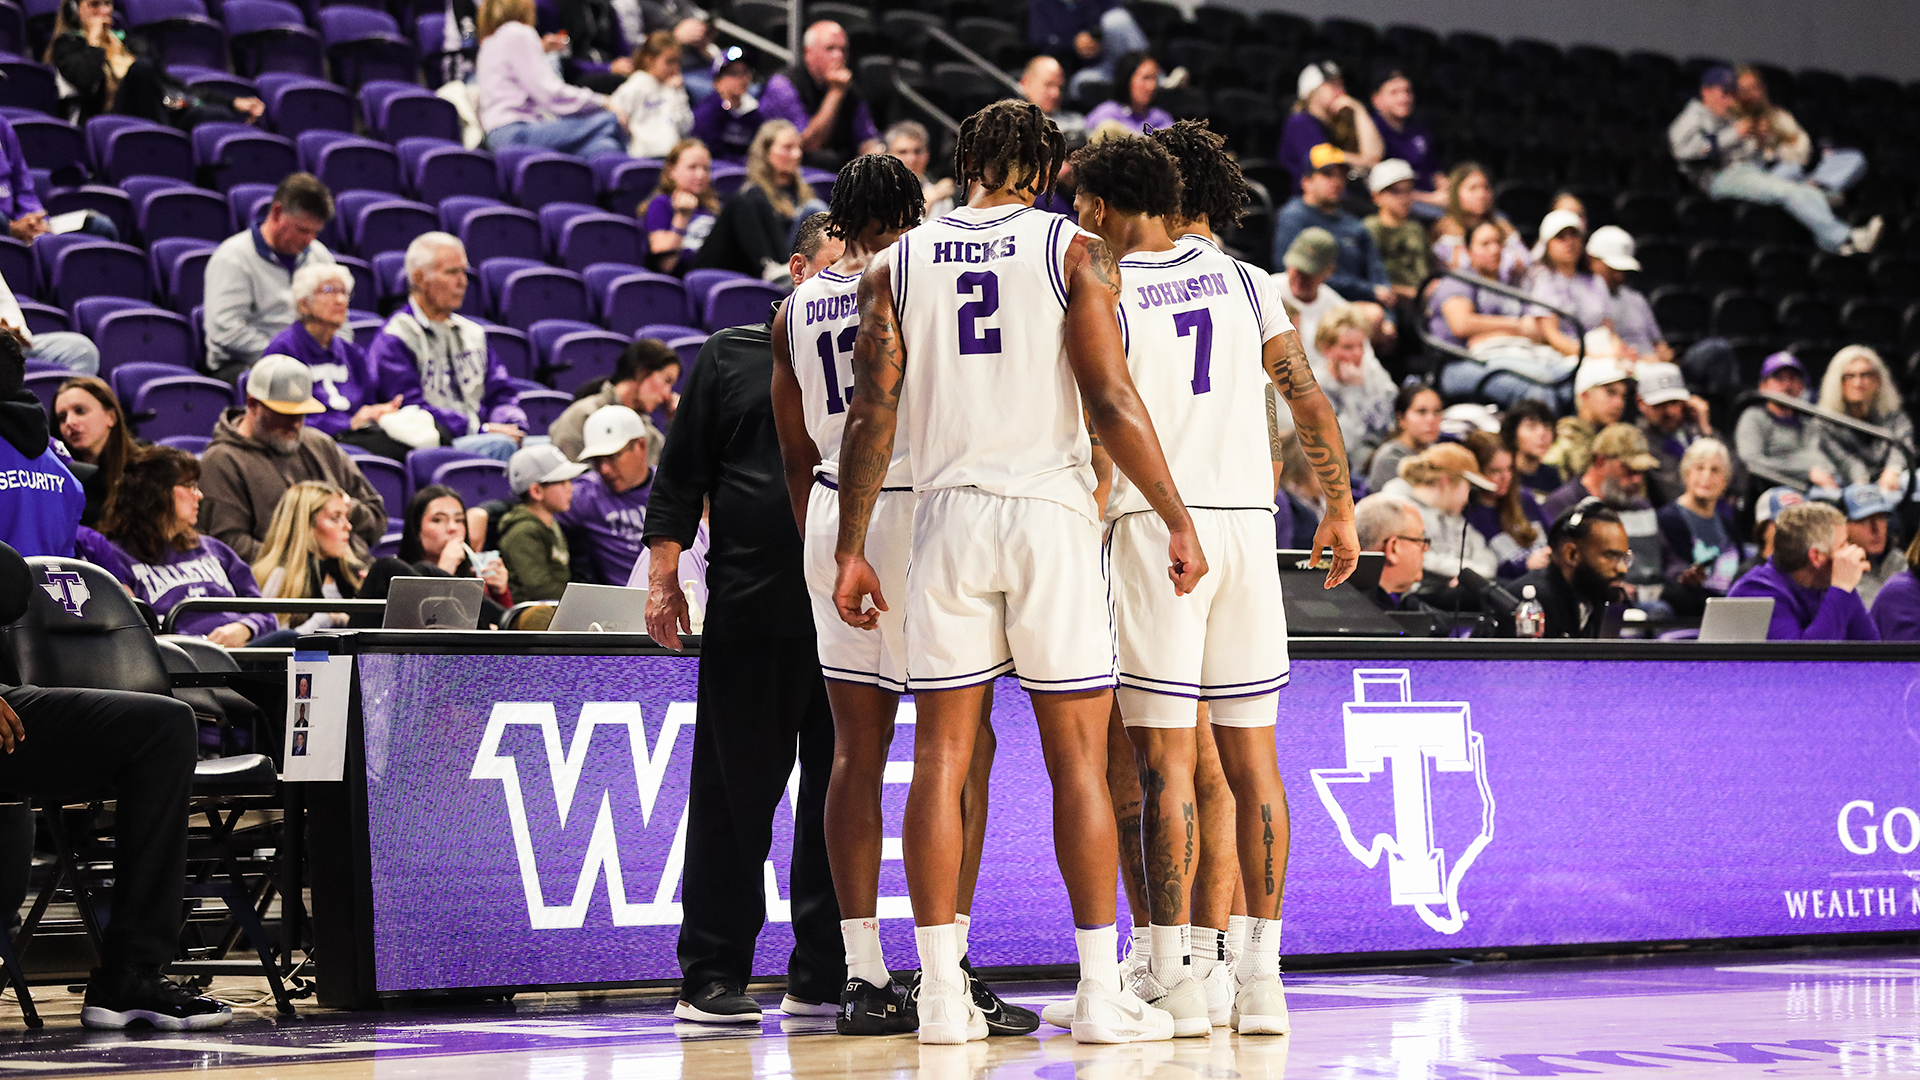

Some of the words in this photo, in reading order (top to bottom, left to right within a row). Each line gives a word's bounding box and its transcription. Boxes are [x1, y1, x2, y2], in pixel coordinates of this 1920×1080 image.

[933, 236, 1016, 263] HICKS
[957, 270, 1002, 355] 2
[1136, 272, 1229, 310] JOHNSON
[1172, 307, 1213, 395] 7
[0, 469, 65, 493] SECURITY
[1182, 802, 1195, 875] MOST
[1261, 803, 1275, 896] HATED
[1784, 887, 1897, 918] WEALTH
